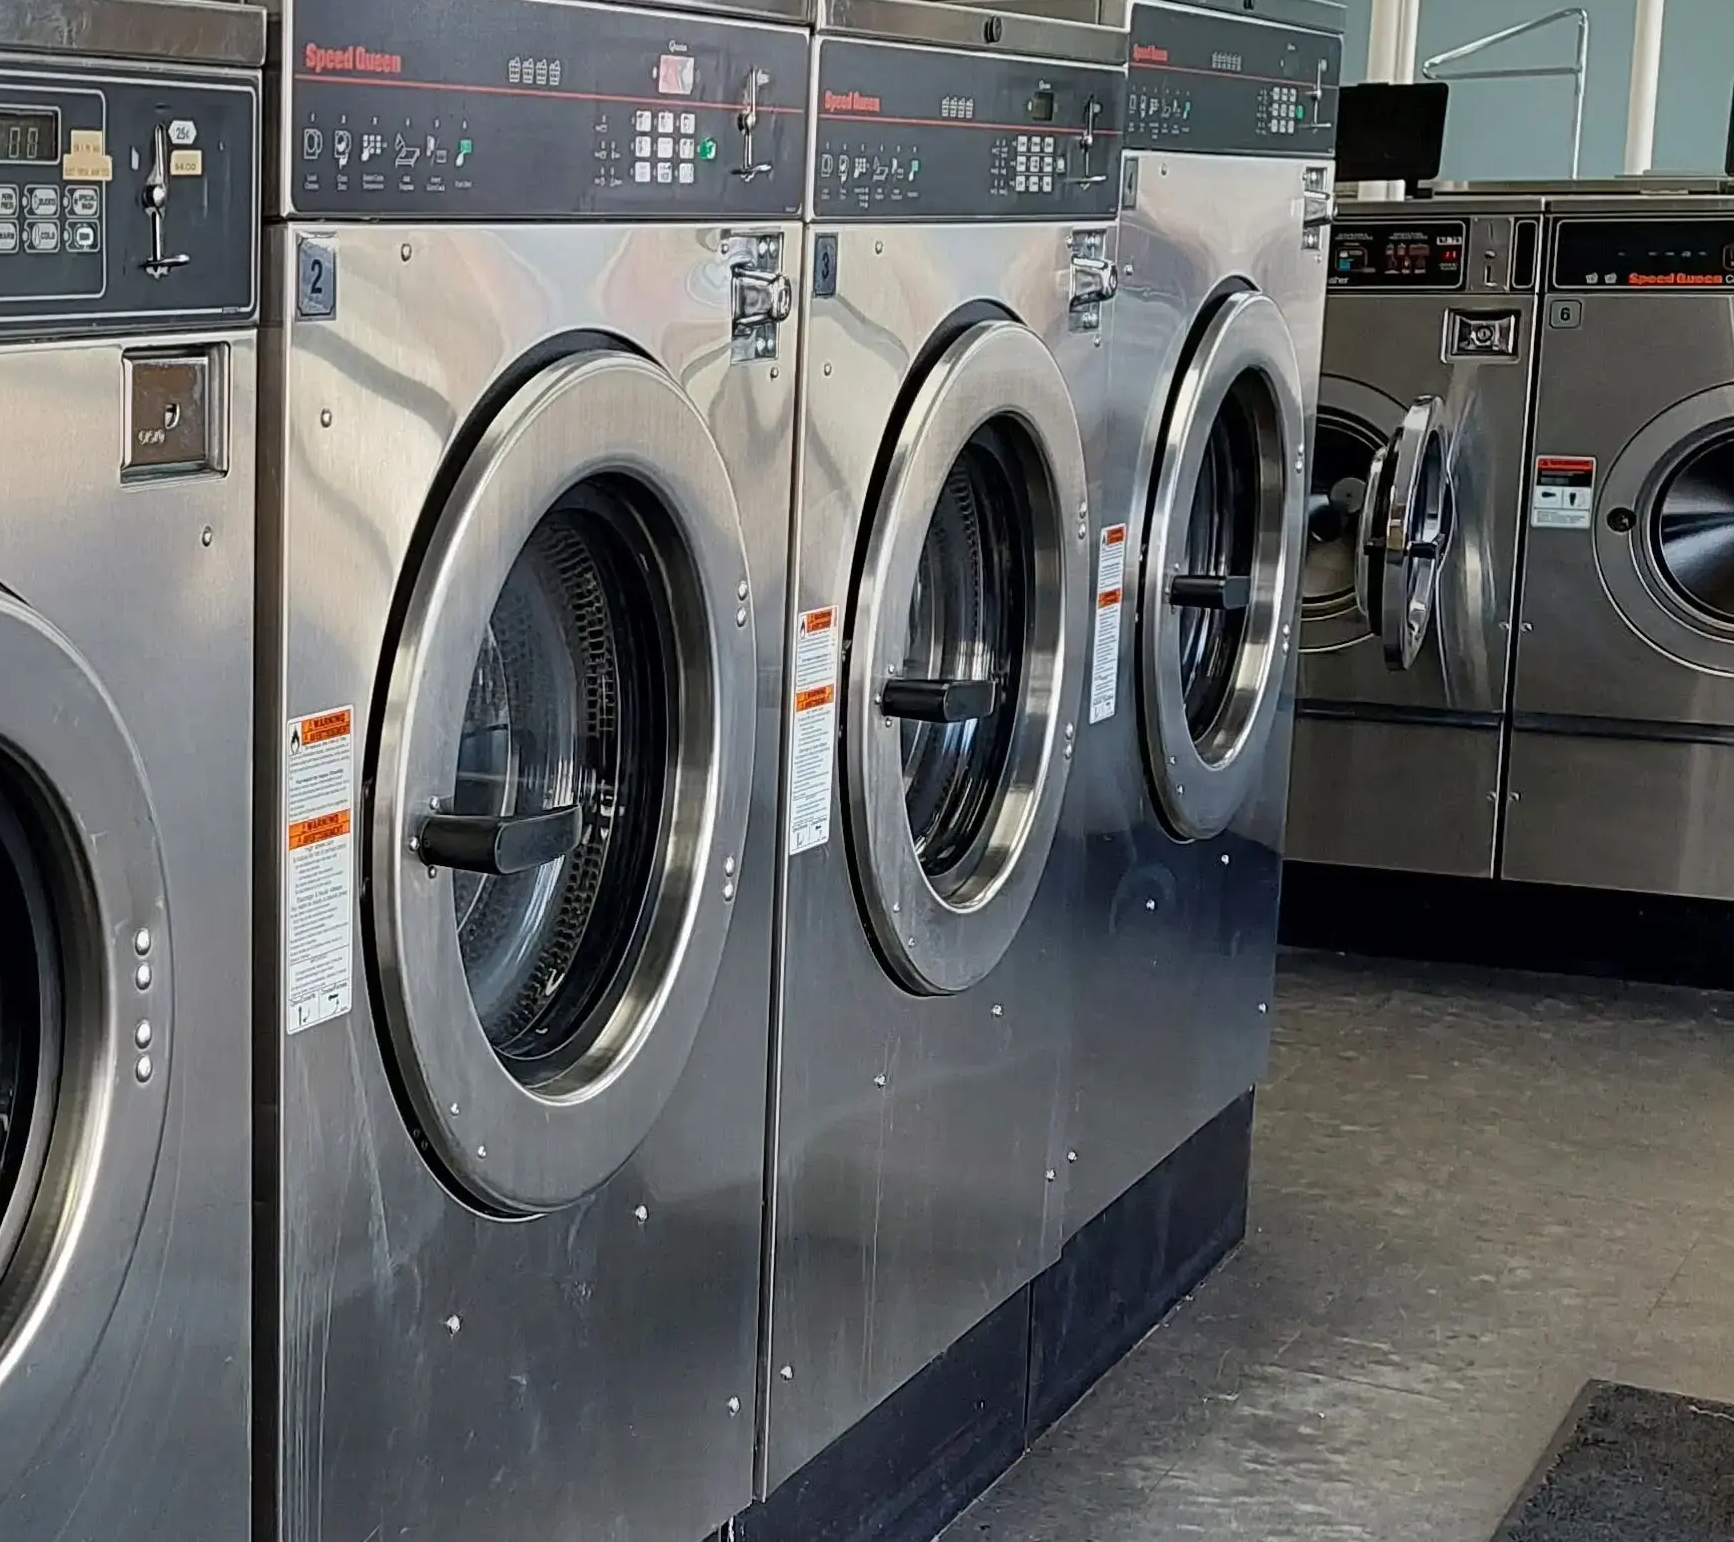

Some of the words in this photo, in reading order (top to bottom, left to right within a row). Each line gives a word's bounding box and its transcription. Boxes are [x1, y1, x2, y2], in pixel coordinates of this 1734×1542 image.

[305, 42, 353, 73] Speed
[355, 46, 402, 73] Queen
[824, 91, 852, 112] Speed
[853, 93, 880, 112] Queen
[0, 232, 15, 240] WARM
[40, 232, 55, 240] COLD
[822, 252, 829, 279] 3
[311, 259, 323, 294] 2
[1628, 273, 1674, 284] Speed
[1677, 273, 1722, 284] Queen
[1560, 307, 1570, 321] 6
